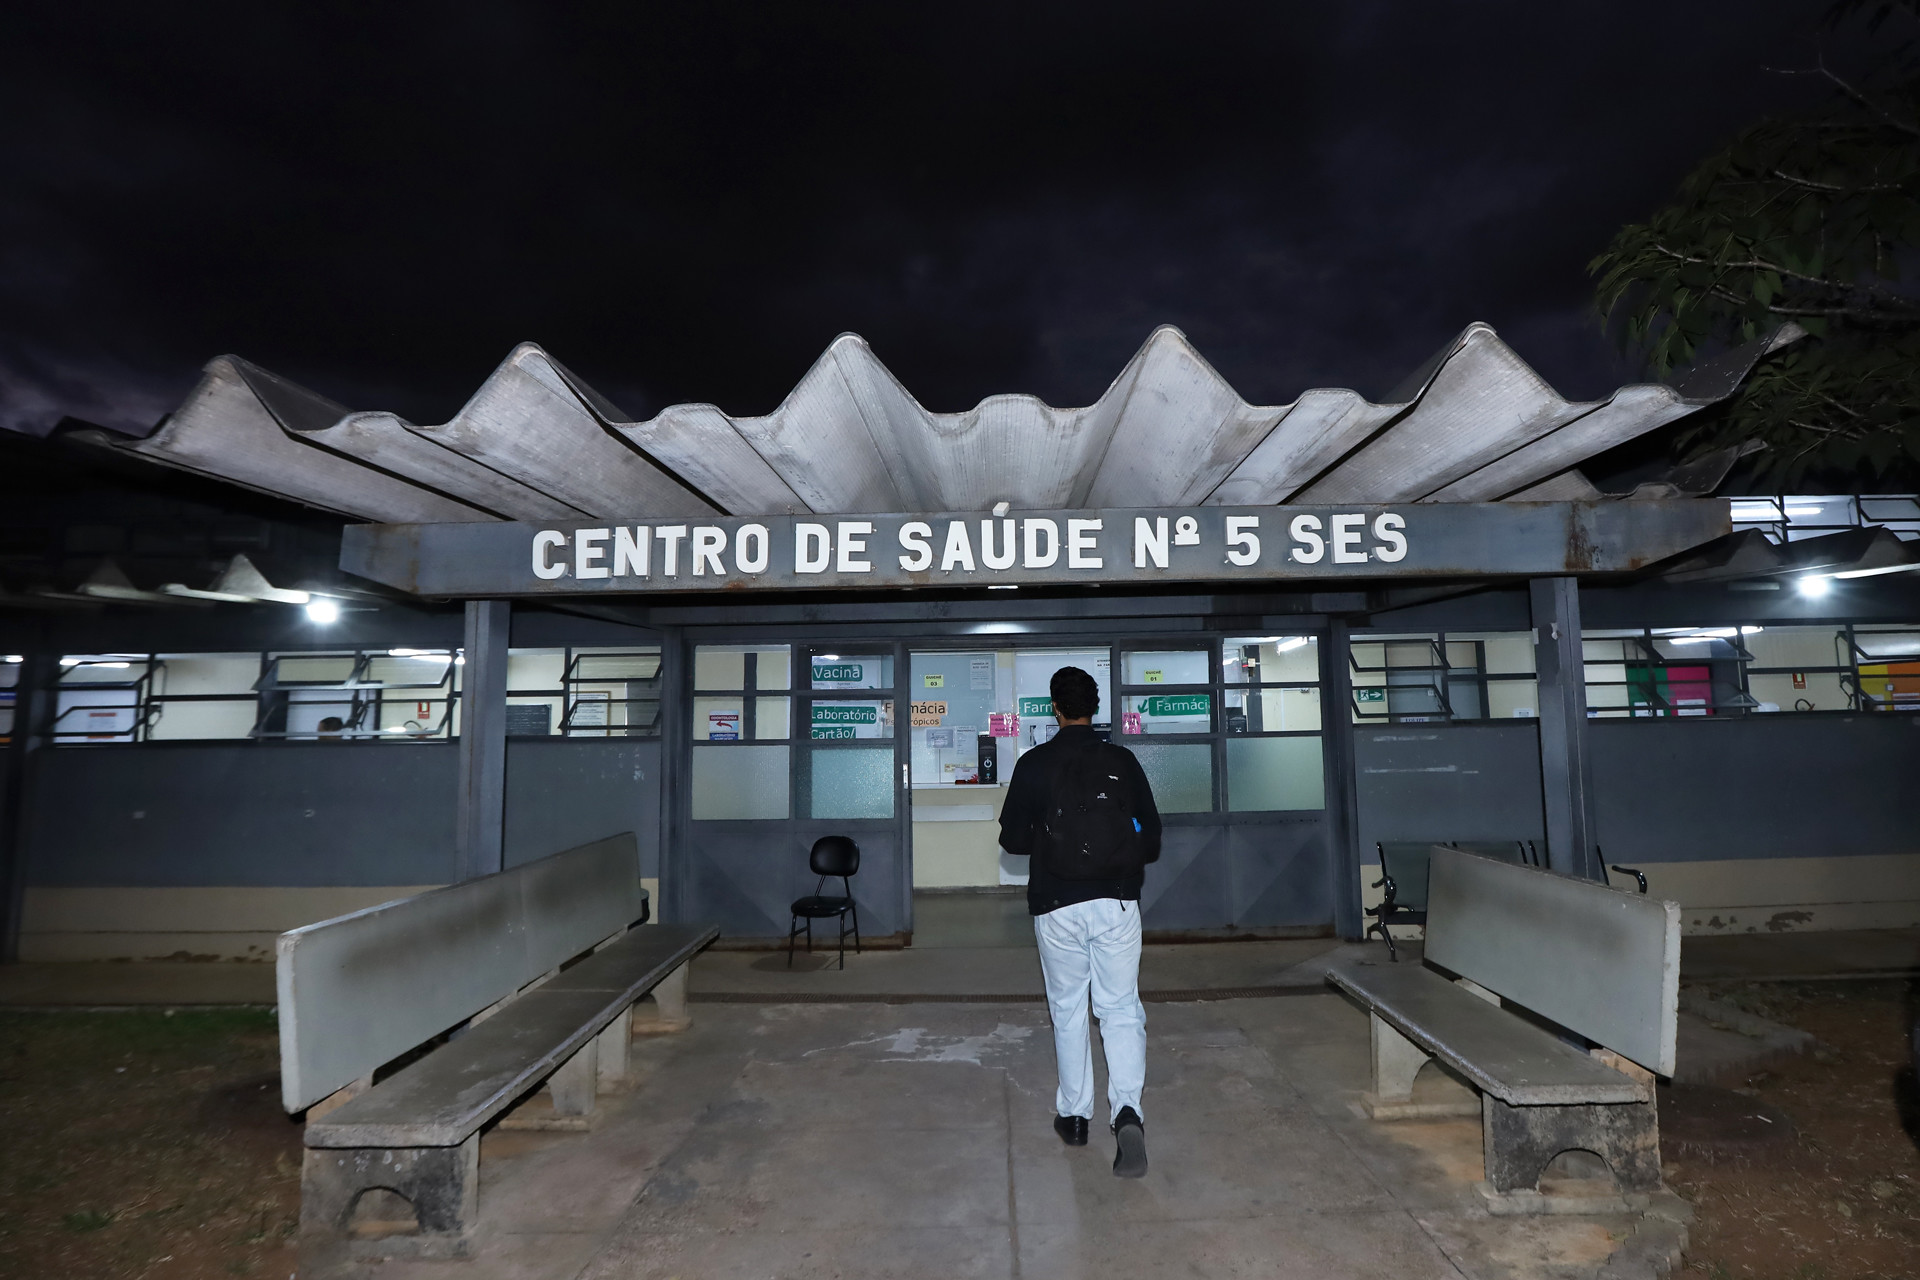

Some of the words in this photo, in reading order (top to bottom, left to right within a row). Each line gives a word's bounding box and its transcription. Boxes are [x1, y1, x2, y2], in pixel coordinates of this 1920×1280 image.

[532, 523, 770, 580] CENTRO
[795, 521, 872, 574] DE
[898, 502, 1104, 572] SAÚDE
[1134, 516, 1200, 568] Nº
[1226, 515, 1261, 566] 5
[1290, 512, 1408, 564] SES
[813, 667, 860, 679] Vacina
[885, 701, 946, 714] Fmácia
[1156, 698, 1210, 711] Farmáci
